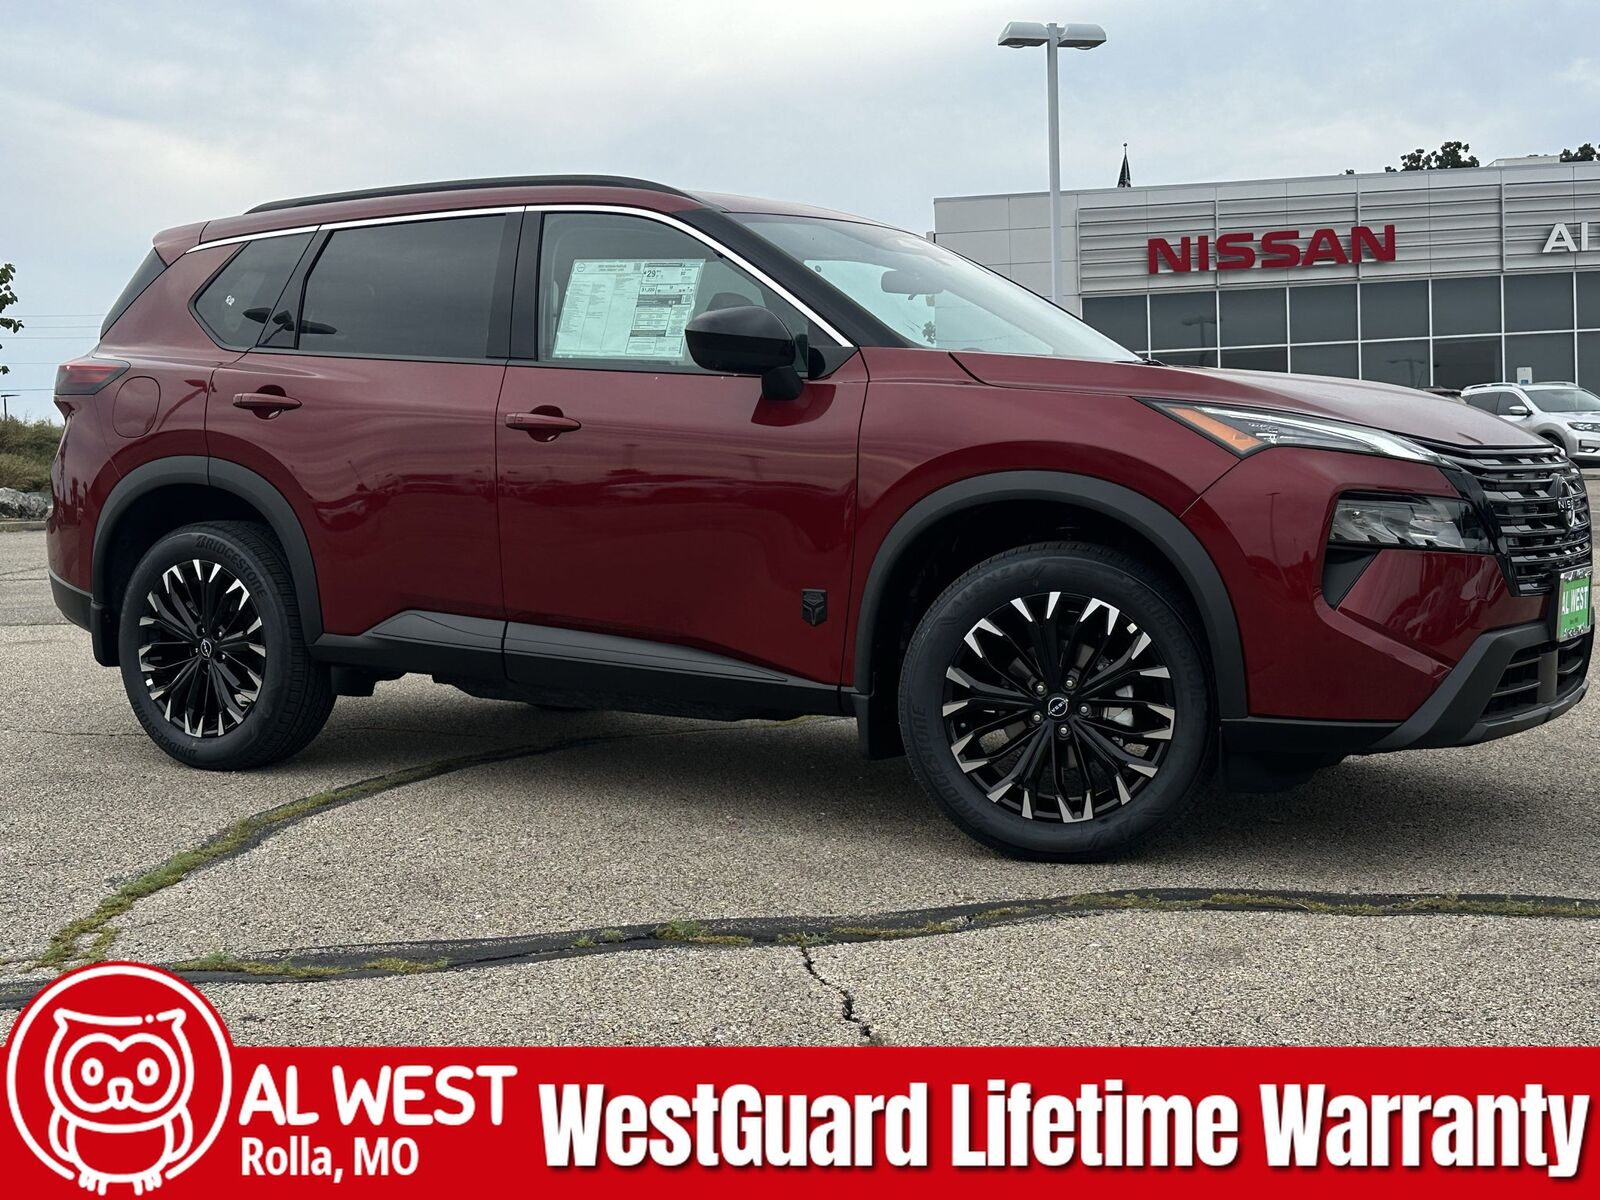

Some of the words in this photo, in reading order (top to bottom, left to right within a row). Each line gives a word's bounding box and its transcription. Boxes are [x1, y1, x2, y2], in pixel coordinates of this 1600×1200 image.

[1148, 224, 1396, 275] NISSAN
[196, 534, 269, 600] BRIDGESTONE
[1561, 590, 1570, 615] AL
[1570, 585, 1589, 613] WEST
